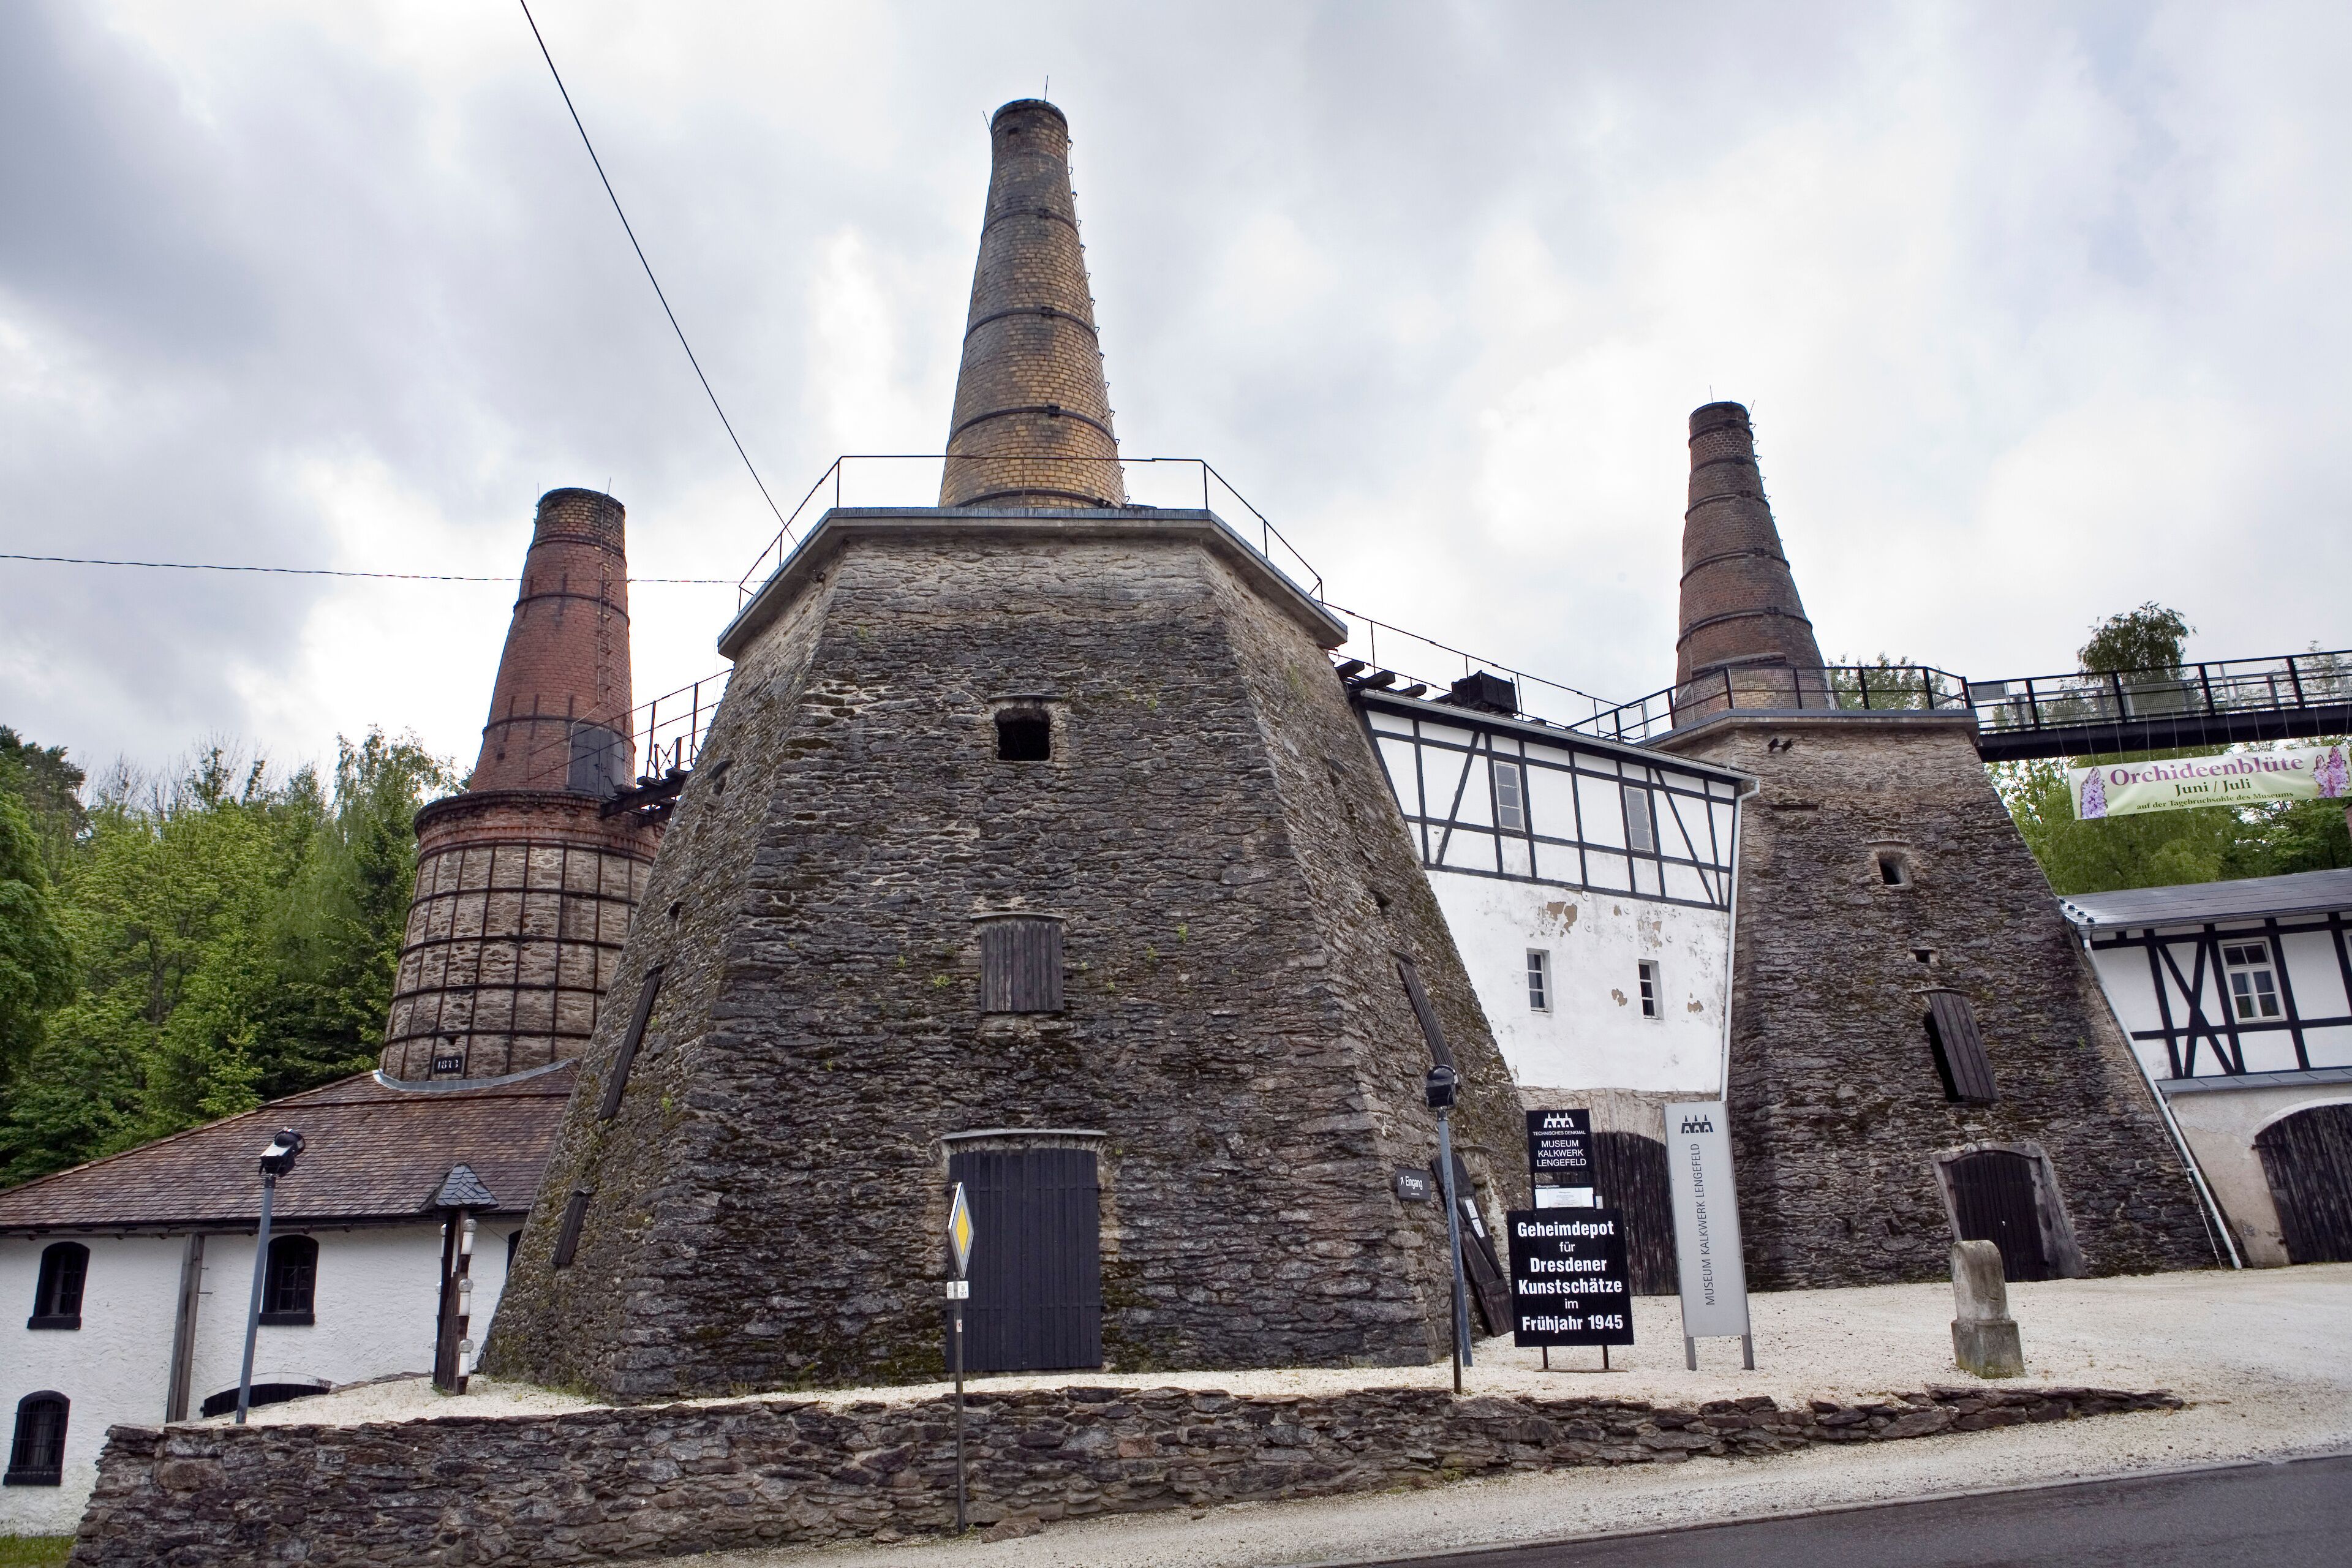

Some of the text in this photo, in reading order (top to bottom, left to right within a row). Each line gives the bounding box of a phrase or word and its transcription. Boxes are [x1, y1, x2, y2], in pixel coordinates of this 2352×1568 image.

[2110, 756, 2304, 786] Orchideenblüte
[2175, 778, 2251, 797] Juni / Juli
[2169, 796, 2234, 807] Tagebruchsohle
[1541, 1139, 1579, 1148] MUSEUM
[1538, 1148, 1584, 1158] KALKWERK
[1537, 1158, 1586, 1167] LENGEFELD
[1405, 1175, 1423, 1190] Eingang
[1517, 1221, 1615, 1238] Geheimdepot
[1690, 1144, 1715, 1305] MUSEUM KALKWERK LENGEFELD
[1559, 1242, 1575, 1252] für
[1530, 1257, 1607, 1273] Dresdener
[1518, 1278, 1623, 1295] Kunstschätze
[1564, 1298, 1578, 1309] im
[1522, 1314, 1623, 1333] Frühjahr 1945
